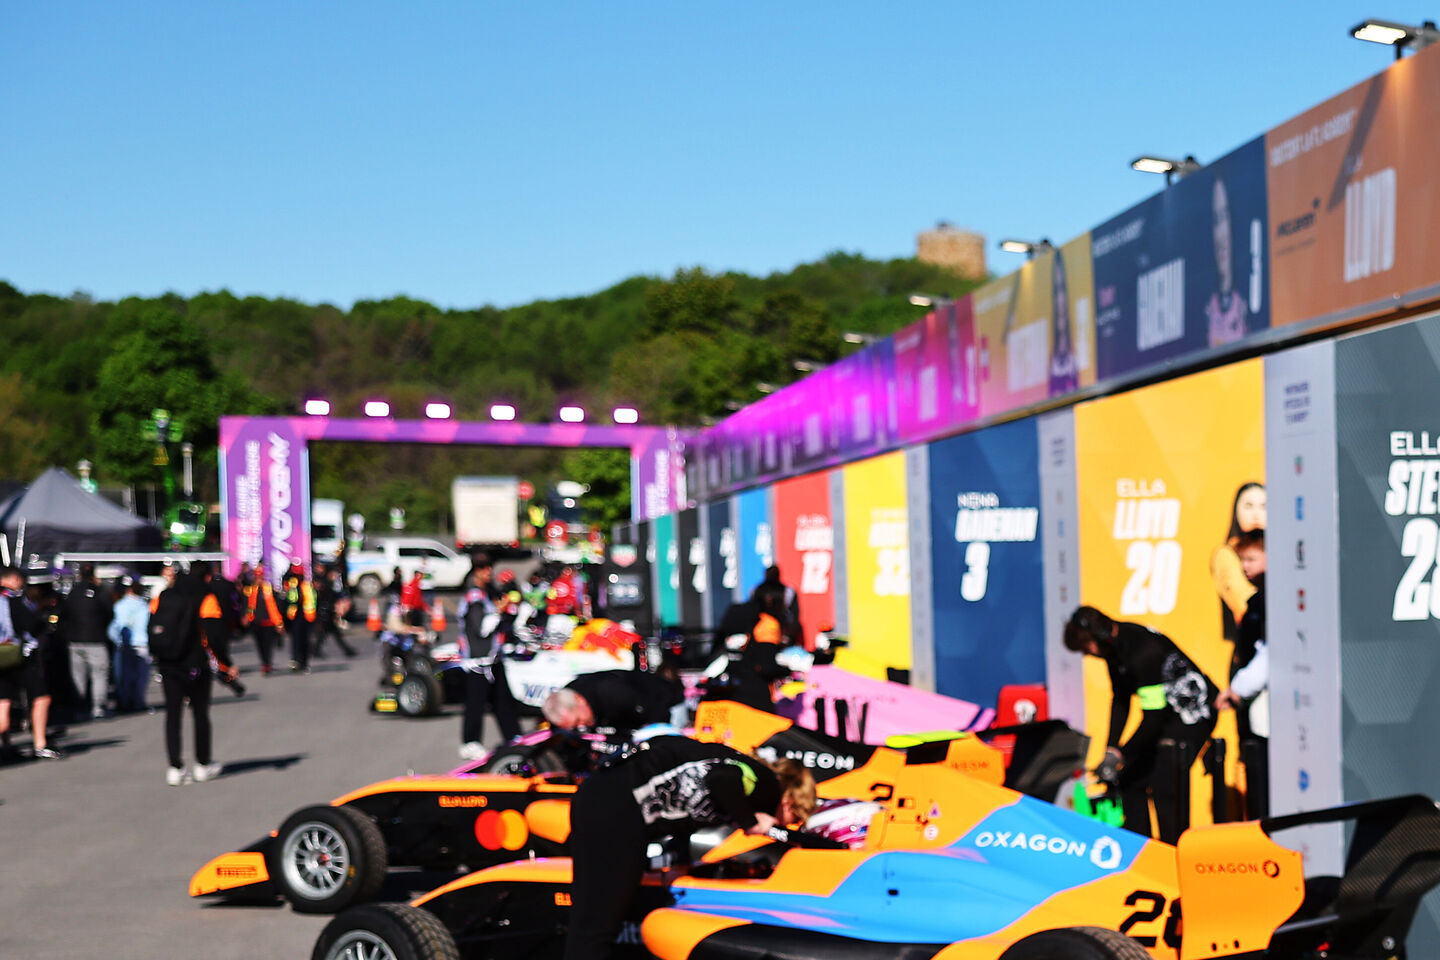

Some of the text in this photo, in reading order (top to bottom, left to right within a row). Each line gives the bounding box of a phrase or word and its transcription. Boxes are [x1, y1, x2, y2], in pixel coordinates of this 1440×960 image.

[1116, 478, 1167, 498] ELLA
[1112, 498, 1182, 540] LLOYD
[960, 541, 991, 602] 3
[1119, 540, 1183, 616] 20
[975, 829, 1087, 858] OXAGON
[216, 865, 257, 879] PIRELLI
[1195, 862, 1259, 875] OXAGON
